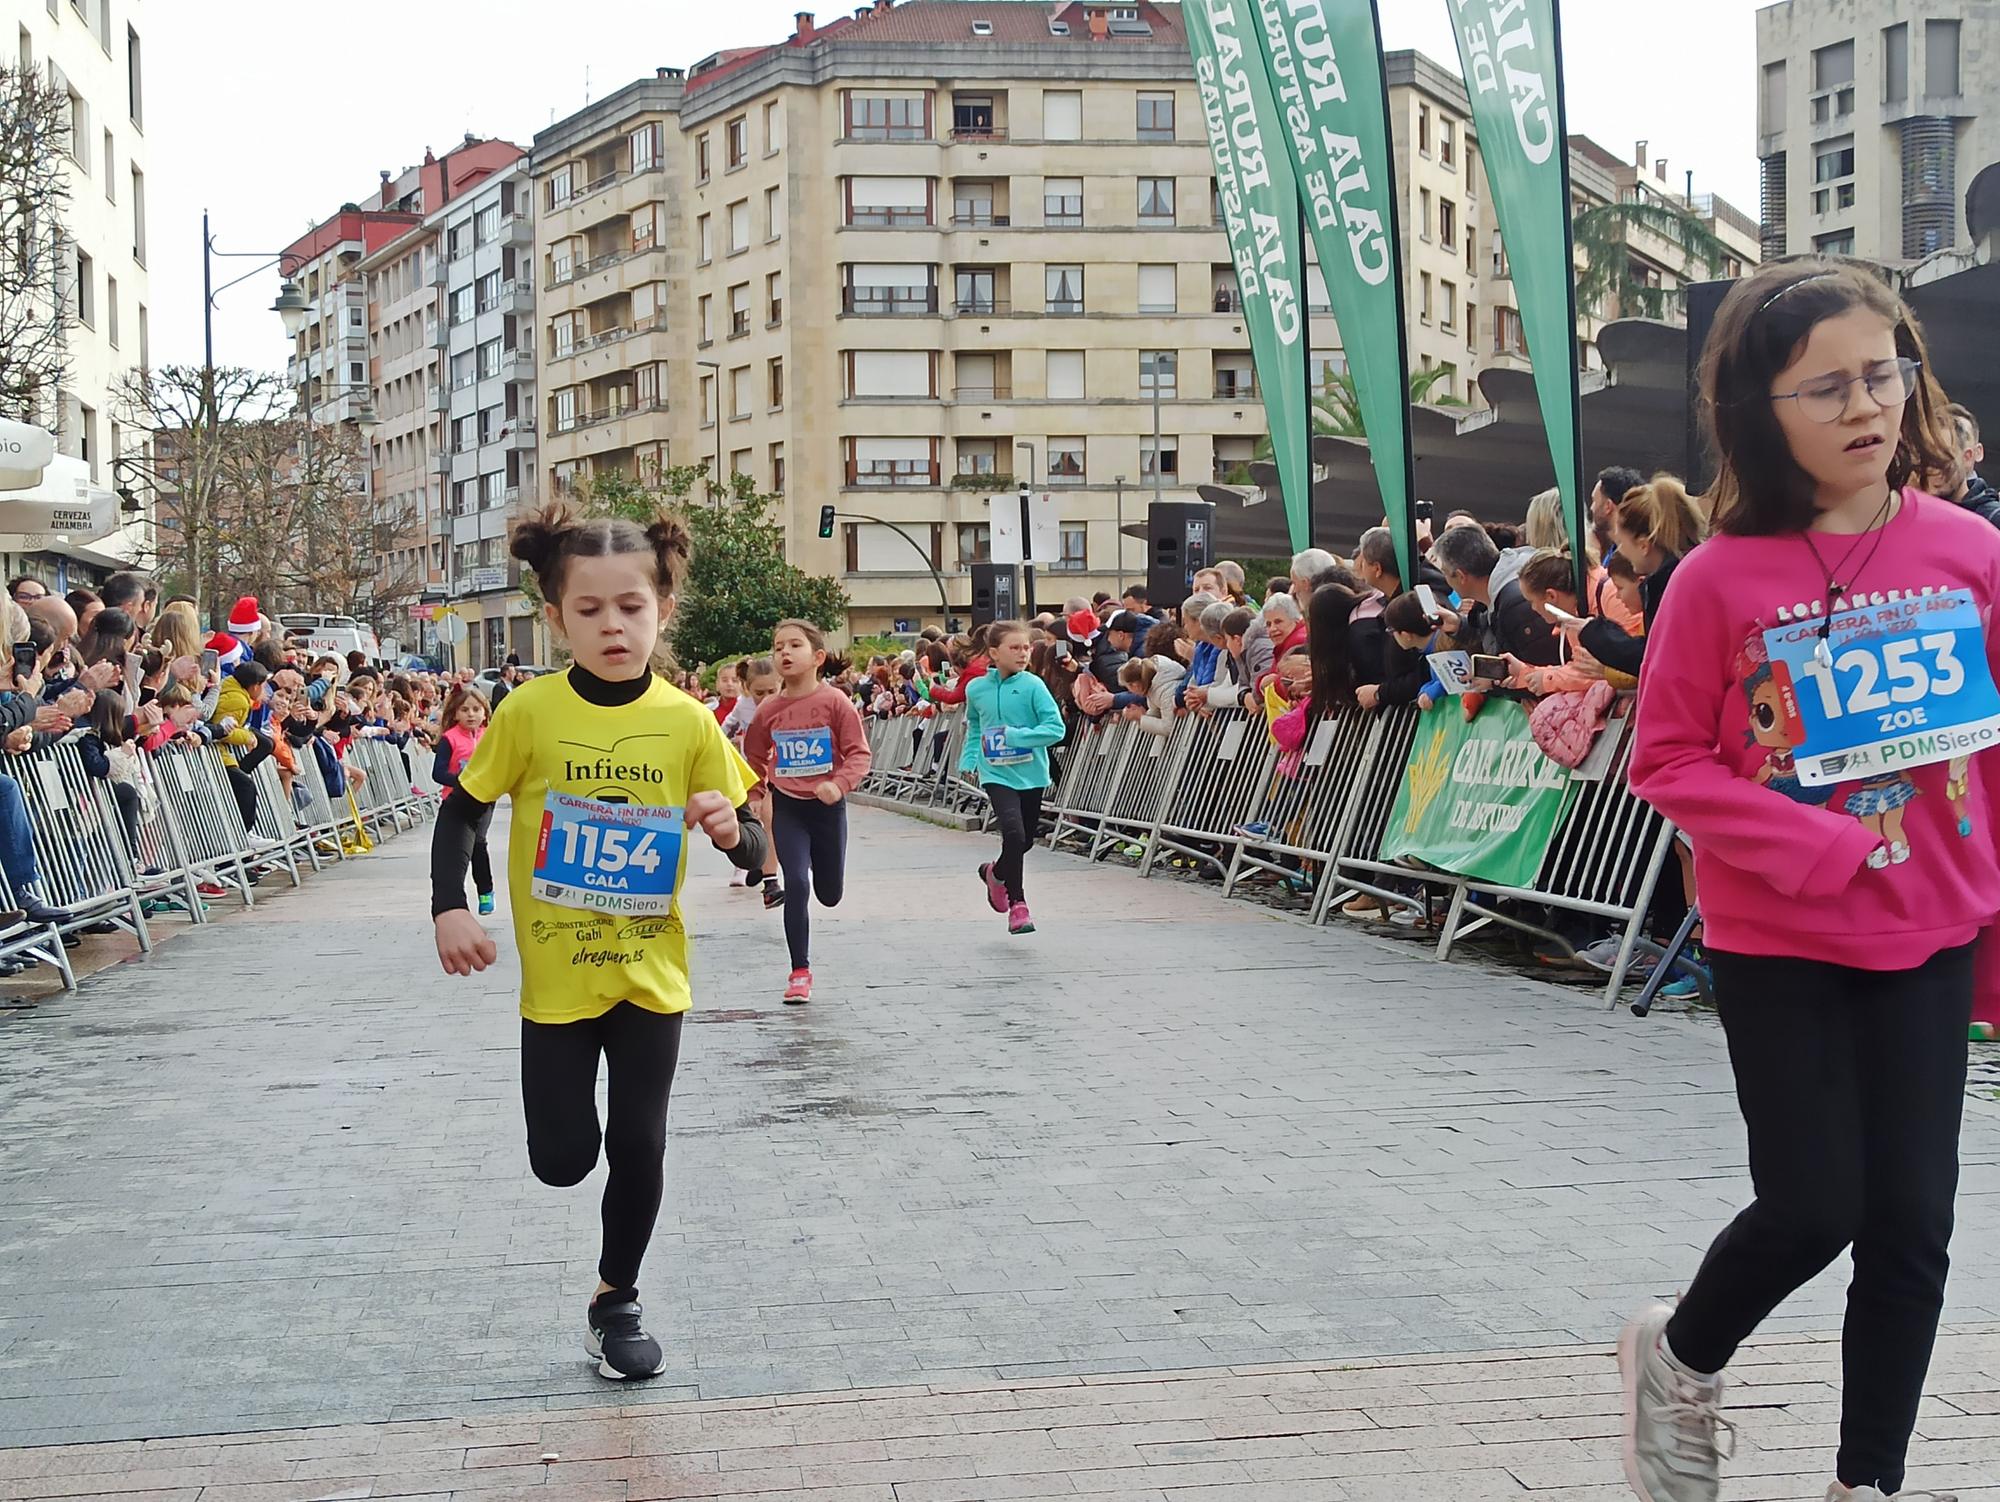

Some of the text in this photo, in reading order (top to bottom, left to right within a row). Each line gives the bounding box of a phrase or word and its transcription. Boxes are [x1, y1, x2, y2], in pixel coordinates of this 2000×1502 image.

[50, 521, 93, 530] ALHAMBRA
[53, 510, 91, 521] CERVEZAS
[1777, 600, 1823, 622] LOS
[1876, 607, 1900, 623] FIN
[1904, 602, 1921, 616] DE
[1926, 595, 1957, 612] AÑO
[1803, 631, 1965, 720] 1253
[1877, 706, 1928, 733] ZOE
[780, 739, 824, 760] 1194
[1880, 727, 1994, 765] PDMSiero
[565, 758, 664, 784] Infiesto
[559, 796, 672, 819] CARRERA FIN DE AÑO
[562, 821, 661, 874] 1154
[584, 872, 629, 889] GALA
[583, 892, 658, 911] PDMSiero
[576, 926, 603, 941] Gabi
